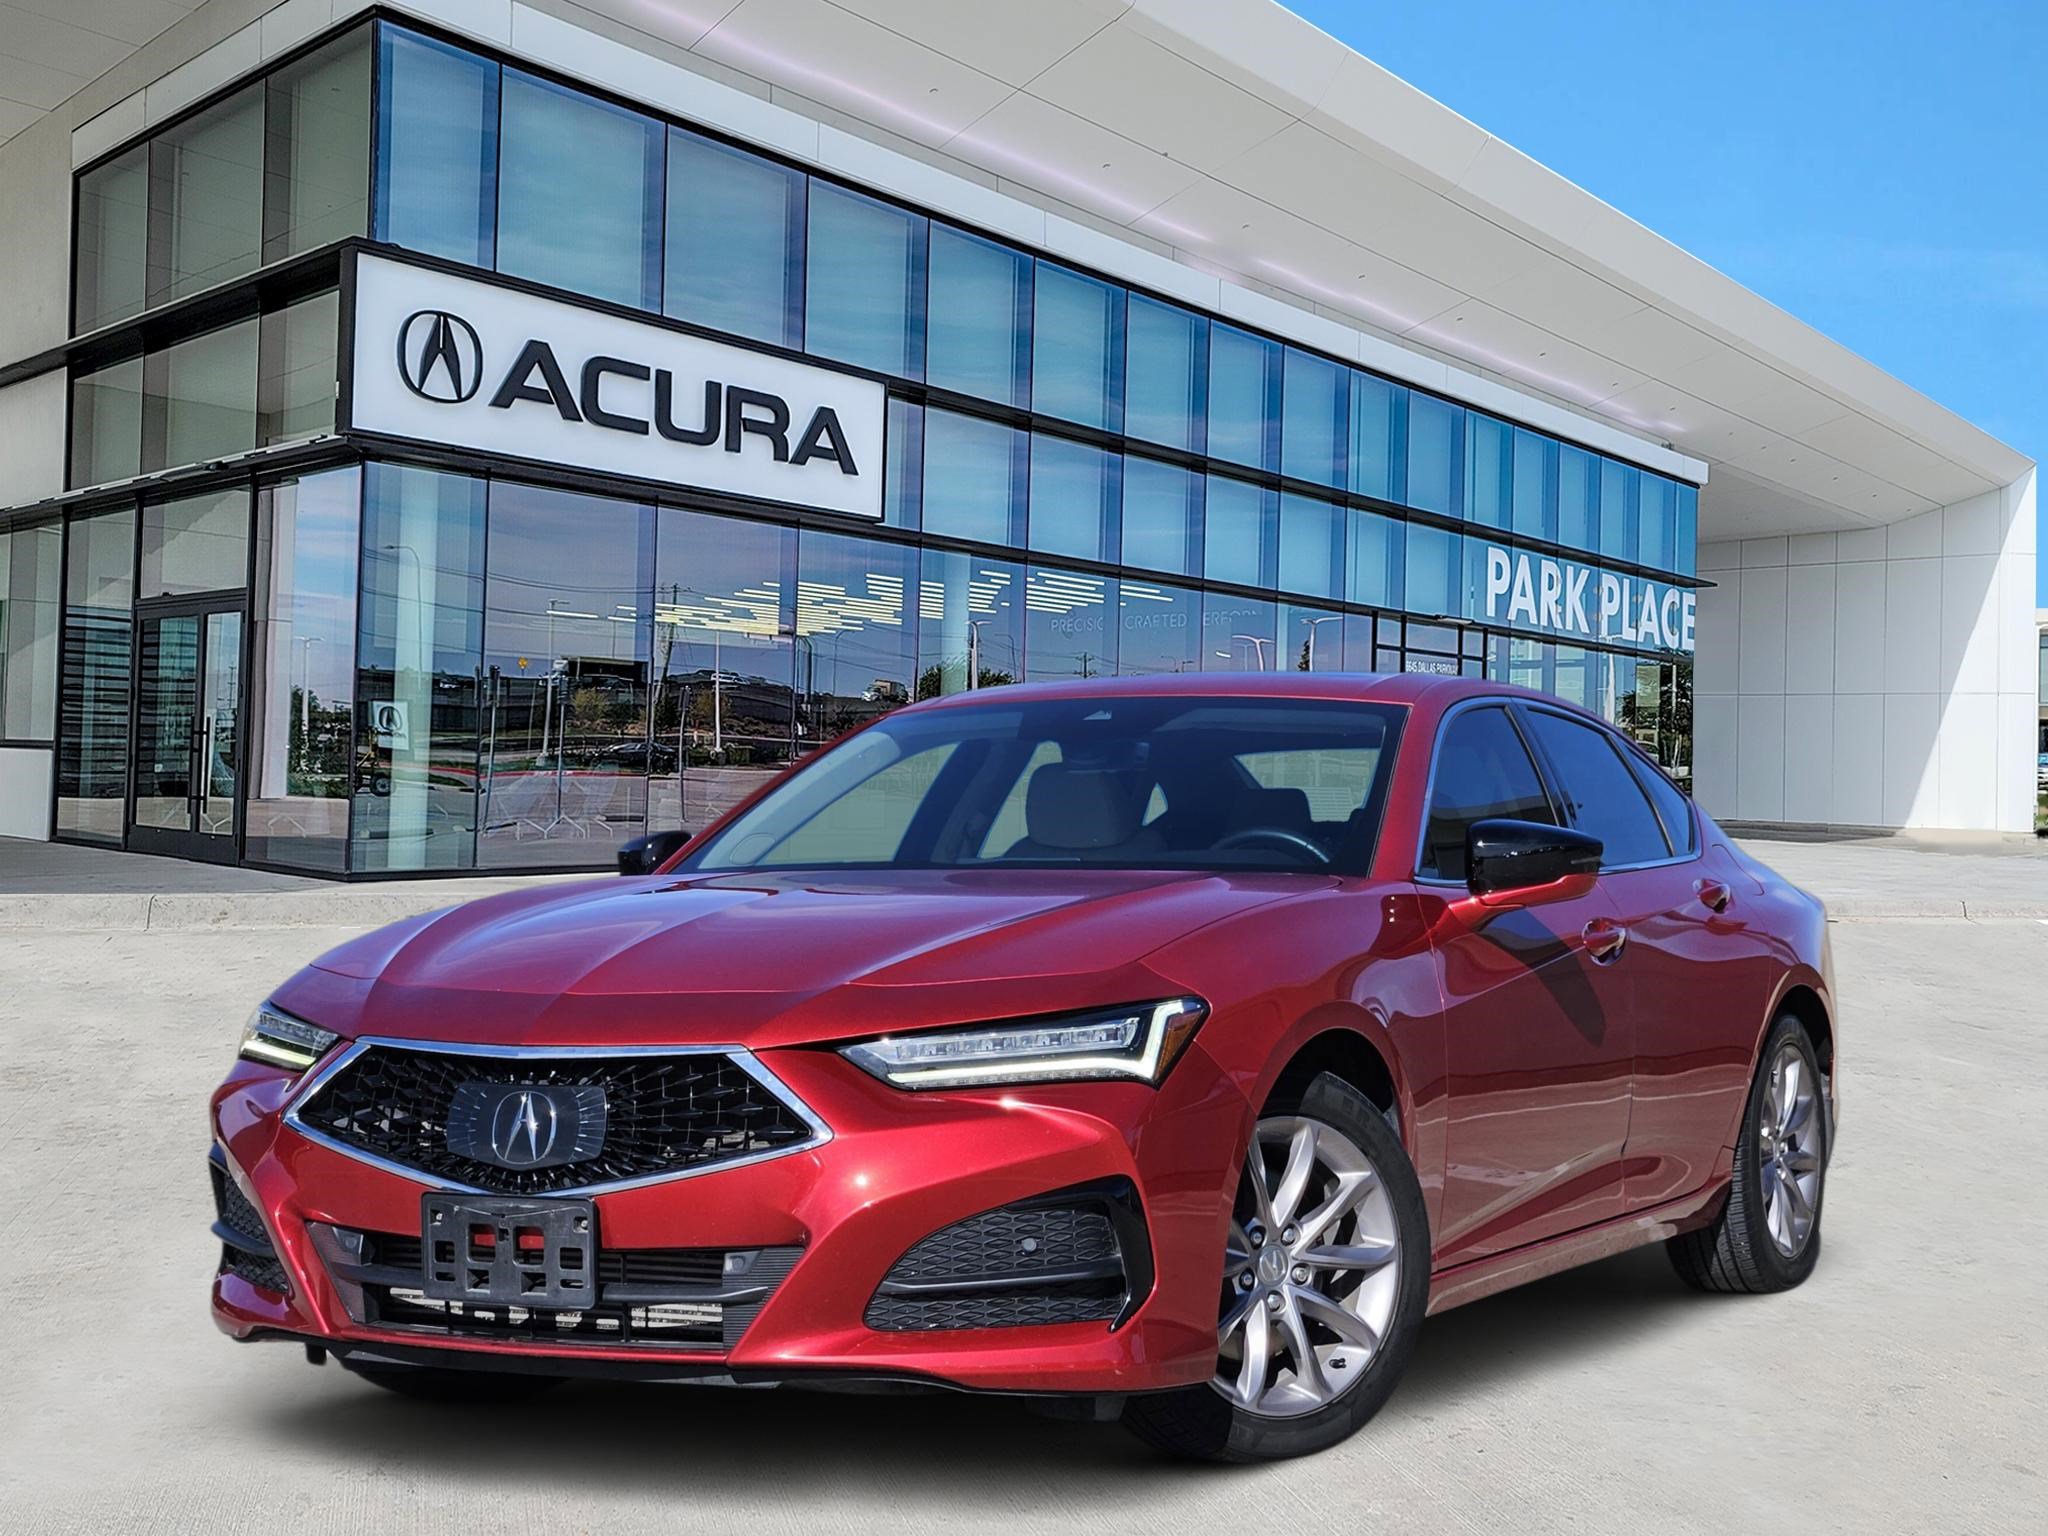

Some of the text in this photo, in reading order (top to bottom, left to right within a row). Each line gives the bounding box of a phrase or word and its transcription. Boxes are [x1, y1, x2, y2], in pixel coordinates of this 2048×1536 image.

[488, 339, 859, 476] ACURA
[1124, 612, 1188, 630] CRAFTED
[1486, 546, 1696, 650] PARK PLACE
